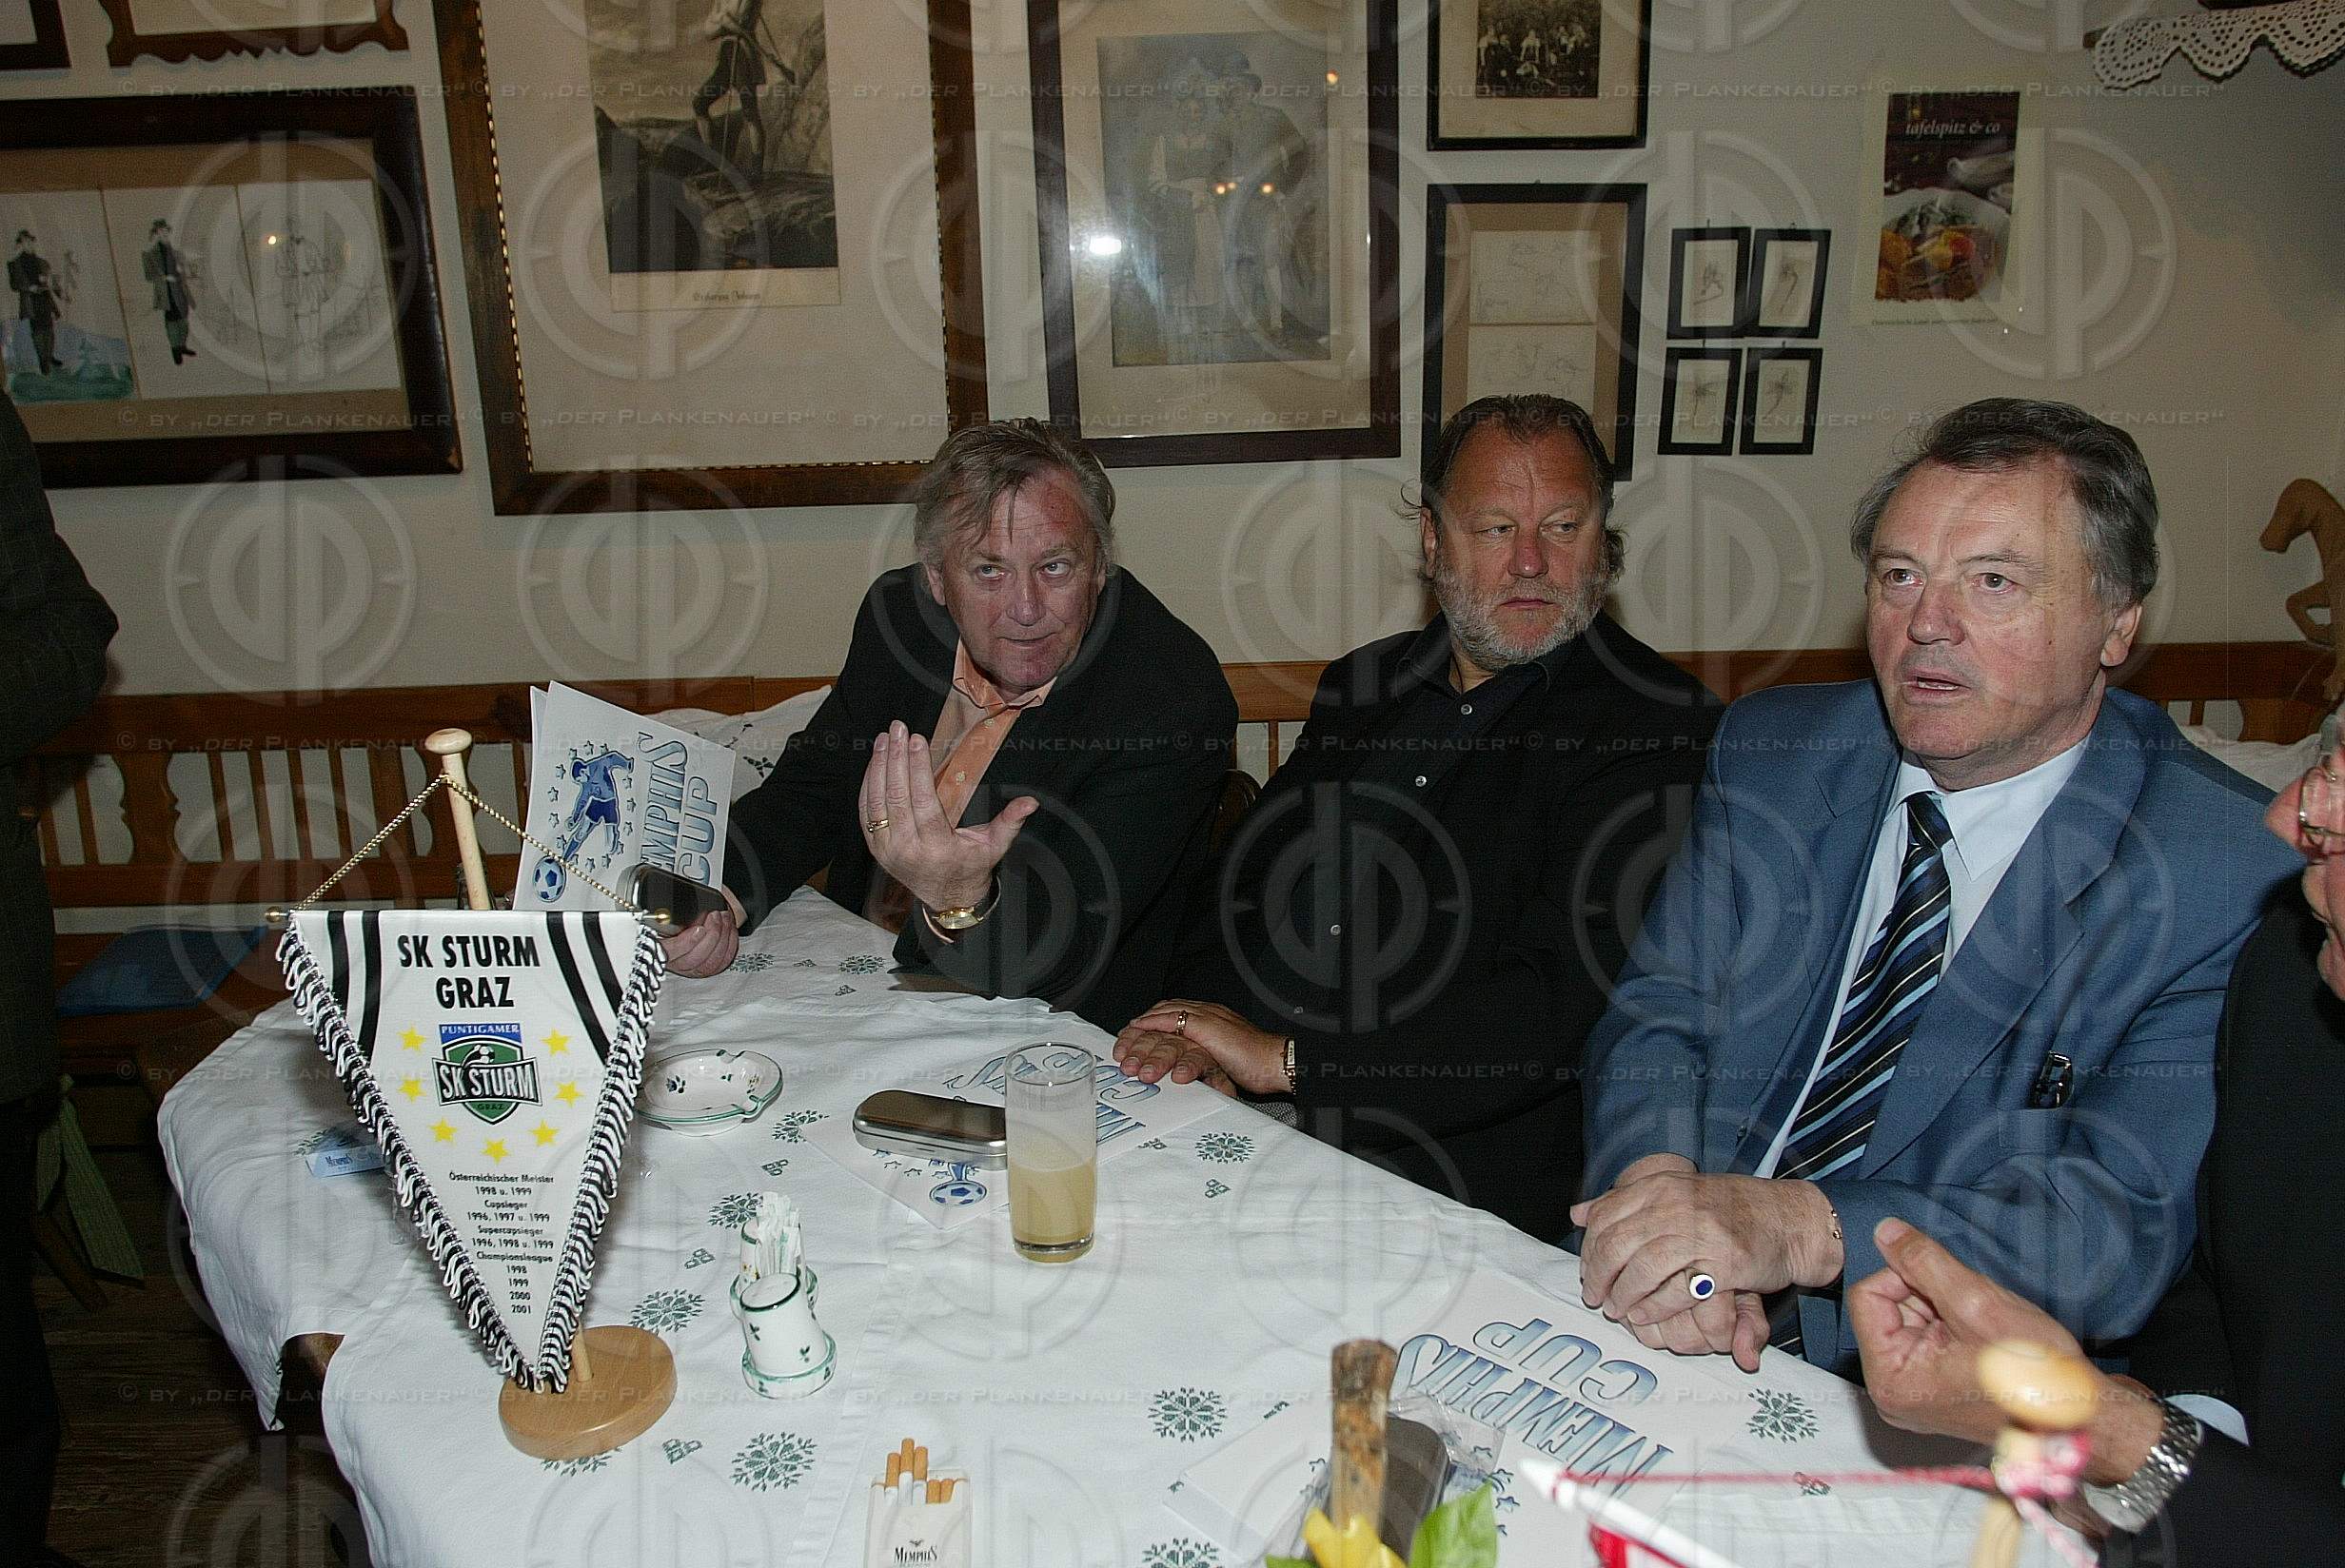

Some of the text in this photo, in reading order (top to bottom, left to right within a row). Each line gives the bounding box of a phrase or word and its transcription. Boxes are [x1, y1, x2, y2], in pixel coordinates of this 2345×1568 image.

[677, 775, 718, 886] CUP
[398, 934, 541, 969] SK STURM
[435, 976, 515, 1009] GRAZ
[441, 1024, 520, 1034] PUNTIGAMER
[439, 1064, 535, 1100] SK STURM
[477, 1103, 504, 1111] GRAZ
[448, 1169, 554, 1185] Österreichischer Meister
[475, 1186, 497, 1196] 1998
[510, 1186, 532, 1197] 1999
[483, 1199, 528, 1210] Cupsieger
[494, 1212, 515, 1222] 1997
[529, 1213, 550, 1223] 1999
[533, 1239, 554, 1249] 1999
[476, 1250, 554, 1264] Championsleague
[506, 1264, 527, 1274] 1998
[508, 1278, 529, 1287] 1999
[509, 1291, 531, 1301] 2000
[510, 1304, 531, 1314] 2001
[1473, 1317, 1658, 1410] CUP
